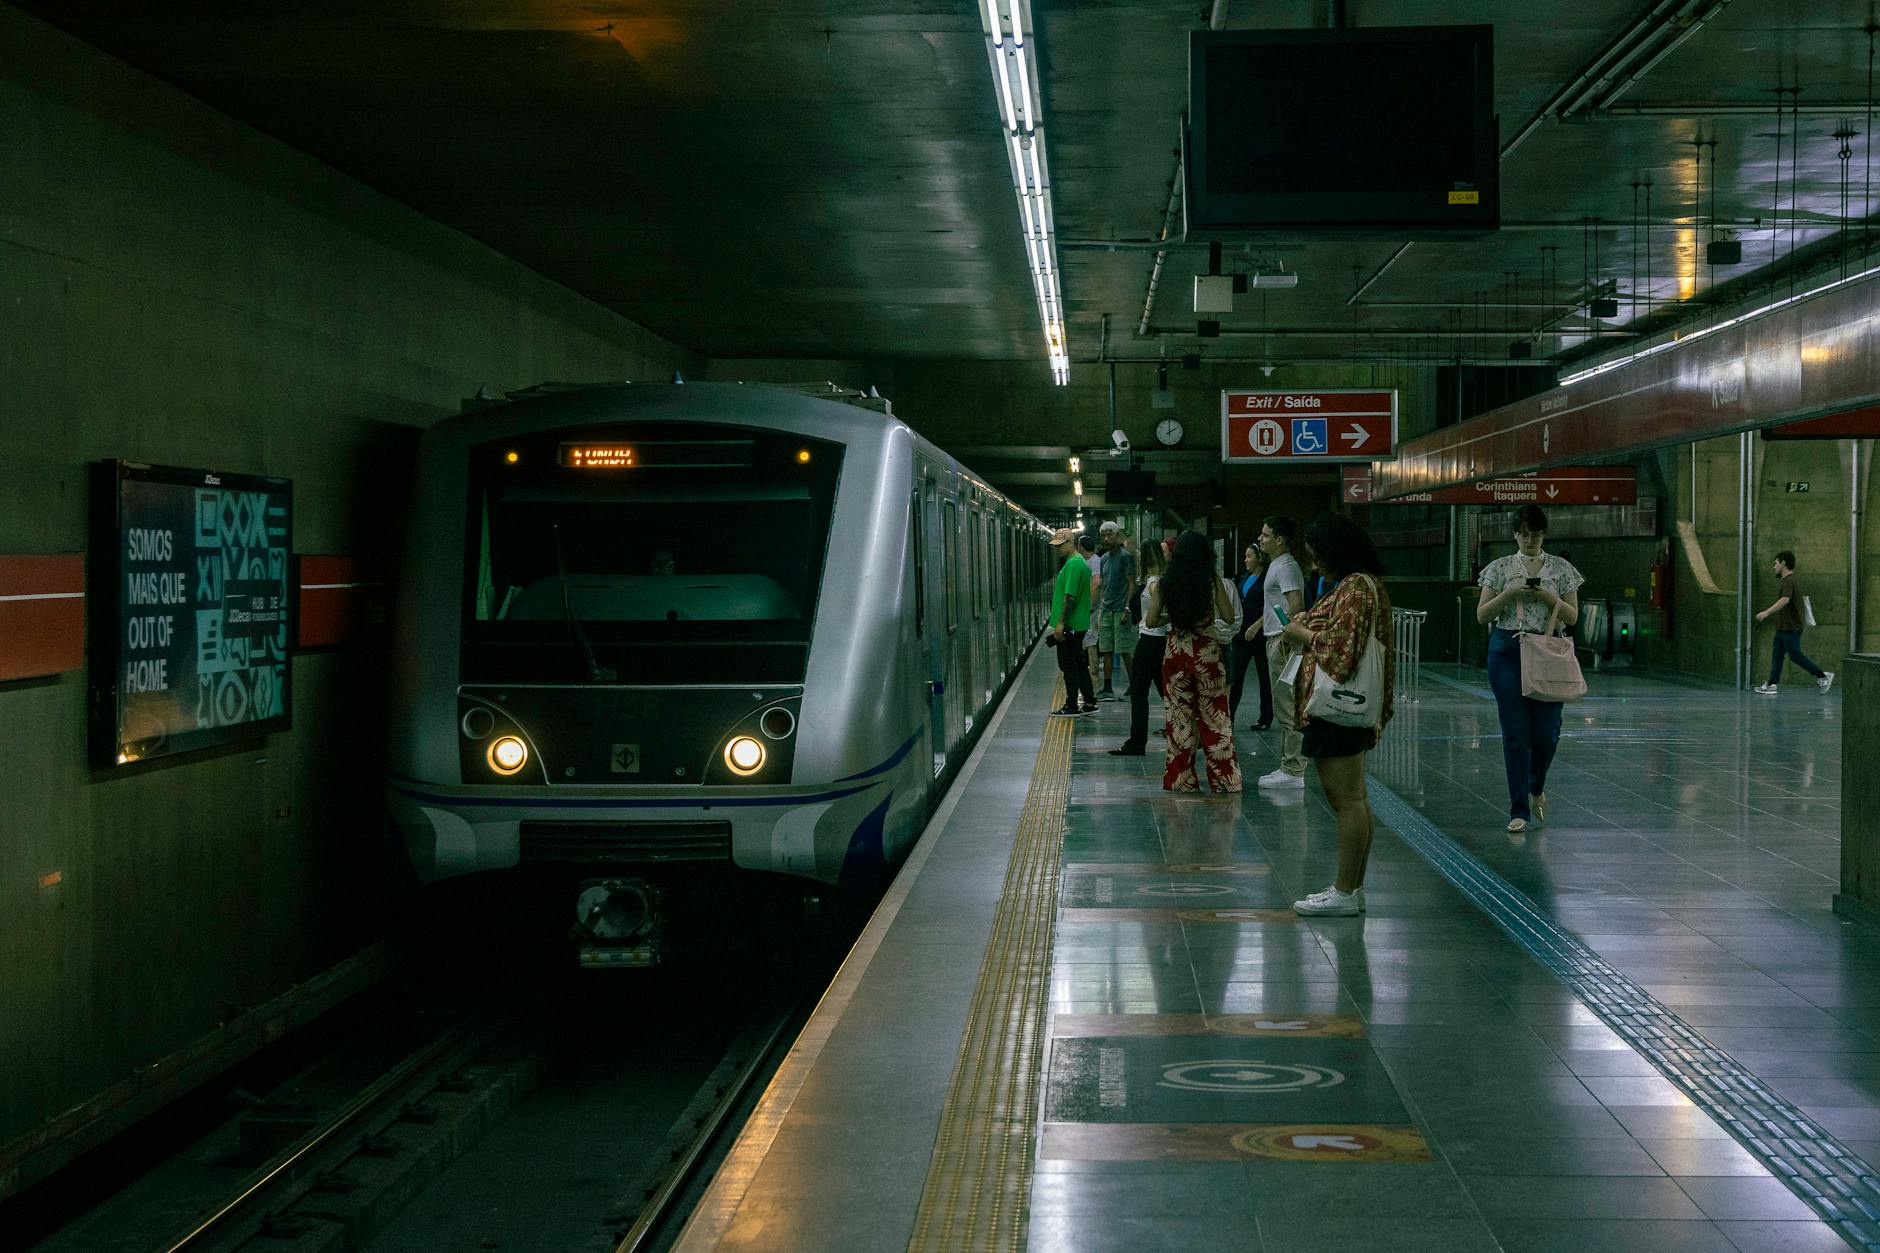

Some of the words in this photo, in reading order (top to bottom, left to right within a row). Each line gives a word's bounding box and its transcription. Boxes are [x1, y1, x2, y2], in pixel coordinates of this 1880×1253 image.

[1246, 396, 1273, 409] Exit
[1284, 395, 1321, 409] Saída
[1399, 492, 1432, 502] unda
[1475, 481, 1538, 491] Corinthians
[1493, 491, 1538, 503] Itaquera
[128, 528, 173, 562] SOMOS
[127, 572, 159, 605] MAIS
[160, 572, 187, 606] QUE
[128, 616, 156, 650] OUT
[157, 615, 174, 648] OF
[126, 658, 169, 694] HOME
